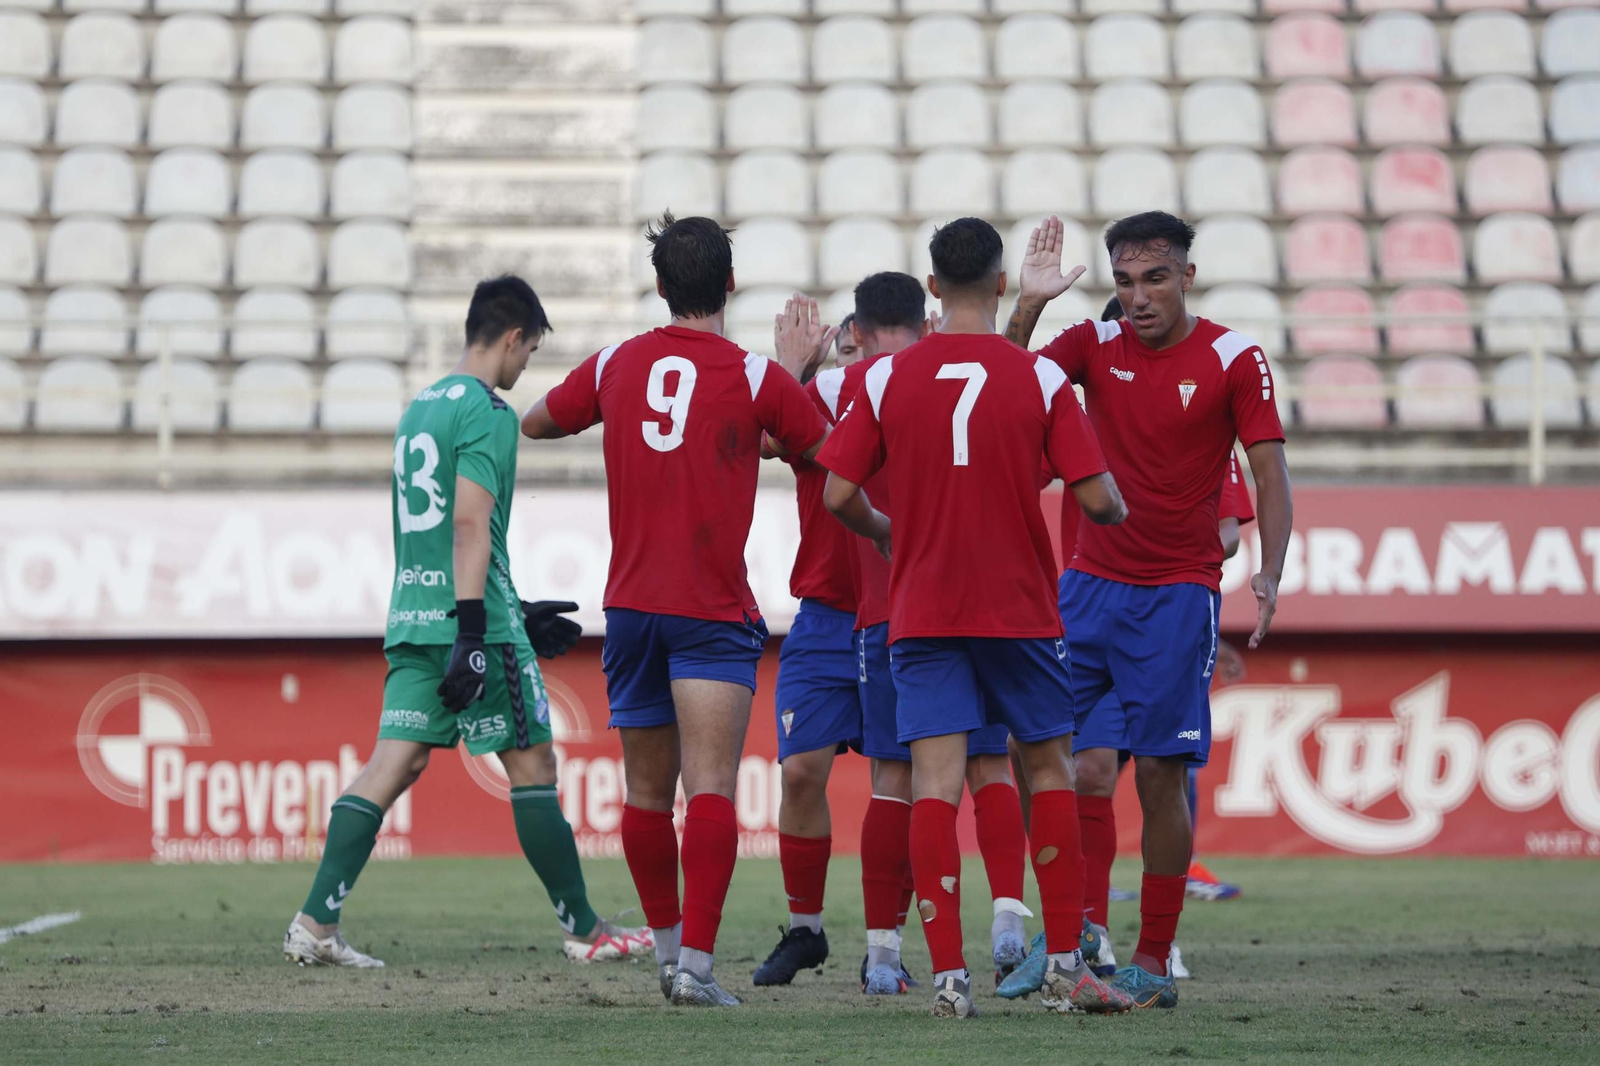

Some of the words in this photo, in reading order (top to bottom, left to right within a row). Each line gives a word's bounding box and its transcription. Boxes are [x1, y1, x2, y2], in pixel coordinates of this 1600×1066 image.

[641, 355, 697, 452] 9
[935, 362, 988, 466] 7
[394, 432, 447, 534] 13
[0, 532, 157, 618] ON
